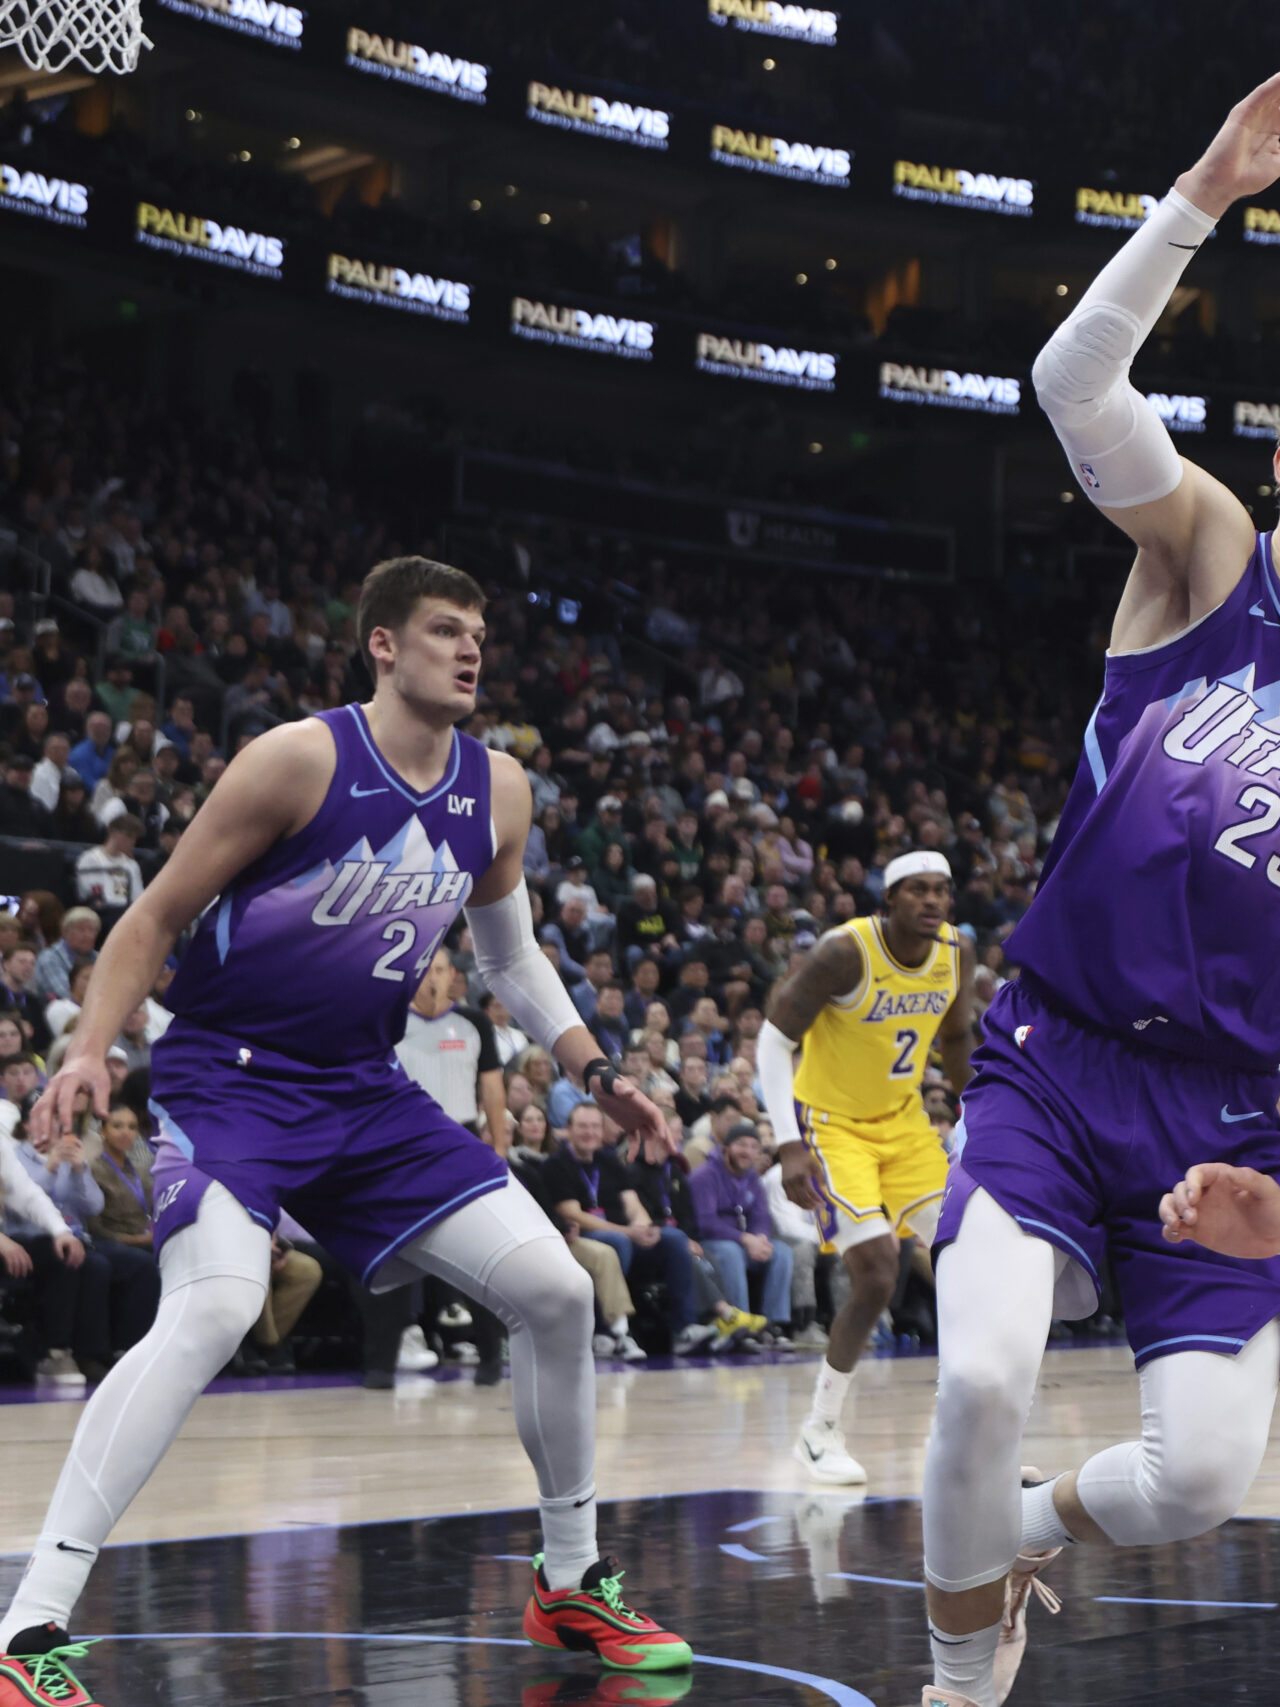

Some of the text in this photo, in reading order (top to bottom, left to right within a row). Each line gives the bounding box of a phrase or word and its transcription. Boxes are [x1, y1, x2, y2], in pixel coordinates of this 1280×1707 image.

[448, 794, 475, 816] LVT
[312, 861, 471, 926] UTAH
[372, 919, 446, 981] 24
[861, 990, 950, 1022] LAKERS
[888, 1029, 919, 1079] 2
